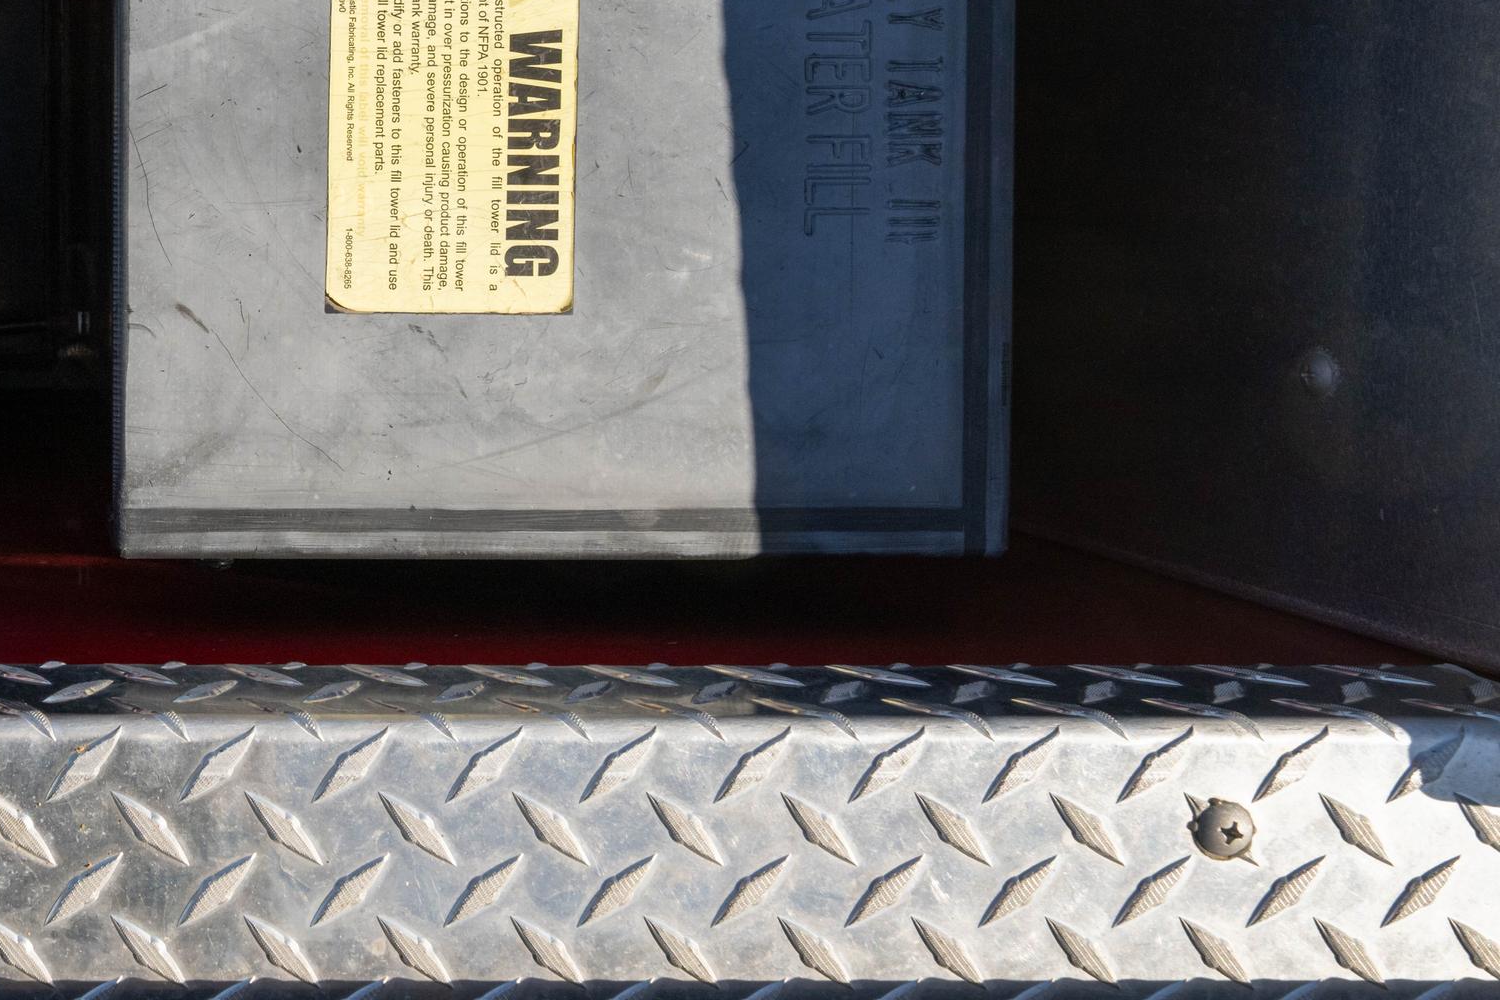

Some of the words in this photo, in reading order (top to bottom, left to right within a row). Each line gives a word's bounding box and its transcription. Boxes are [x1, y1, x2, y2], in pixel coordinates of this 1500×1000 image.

[376, 10, 388, 43] tower
[444, 8, 455, 19] in
[478, 11, 489, 22] of
[346, 17, 356, 64] Fabricating,
[393, 24, 402, 36] or
[443, 23, 452, 50] over
[460, 31, 470, 43] to
[376, 47, 388, 60] lid
[392, 41, 404, 63] add
[408, 21, 422, 75] warranty.
[427, 45, 439, 67] and
[477, 26, 489, 61] NFPA
[459, 49, 470, 67] the
[347, 66, 355, 80] Inc.
[477, 65, 489, 97] 1901.
[347, 82, 355, 93] All
[391, 68, 403, 123] fasteners
[426, 72, 435, 112] severe
[439, 54, 454, 137] pressurization
[456, 73, 470, 112] design
[490, 59, 504, 117] operation
[345, 96, 355, 121] Rights
[373, 64, 387, 138] replacement
[884, 56, 945, 168] TANK
[391, 128, 402, 140] to
[458, 119, 467, 131] or
[492, 126, 503, 139] of
[346, 123, 354, 162] Reserved
[391, 144, 402, 165] this
[423, 117, 437, 168] personal
[504, 29, 563, 277] WARNING
[372, 142, 385, 174] parts.
[438, 142, 452, 187] causing
[454, 137, 469, 192] operation
[491, 148, 503, 167] the
[390, 170, 402, 182] fill
[422, 173, 436, 205] injury
[491, 176, 503, 189] fill
[804, 134, 874, 237] FILL
[390, 188, 401, 221] tower
[424, 209, 433, 222] or
[438, 192, 451, 236] product
[456, 198, 468, 210] of
[490, 199, 501, 233] tower
[389, 225, 401, 238] lid
[456, 215, 467, 236] this
[389, 243, 399, 265] and
[423, 225, 435, 261] death.
[456, 241, 467, 254] fill
[490, 243, 501, 256] lid
[343, 228, 353, 289] 1-800-638-8265
[436, 241, 450, 290] damage,
[489, 265, 501, 275] is
[388, 270, 397, 290] use
[422, 266, 434, 291] This
[454, 259, 466, 292] tower
